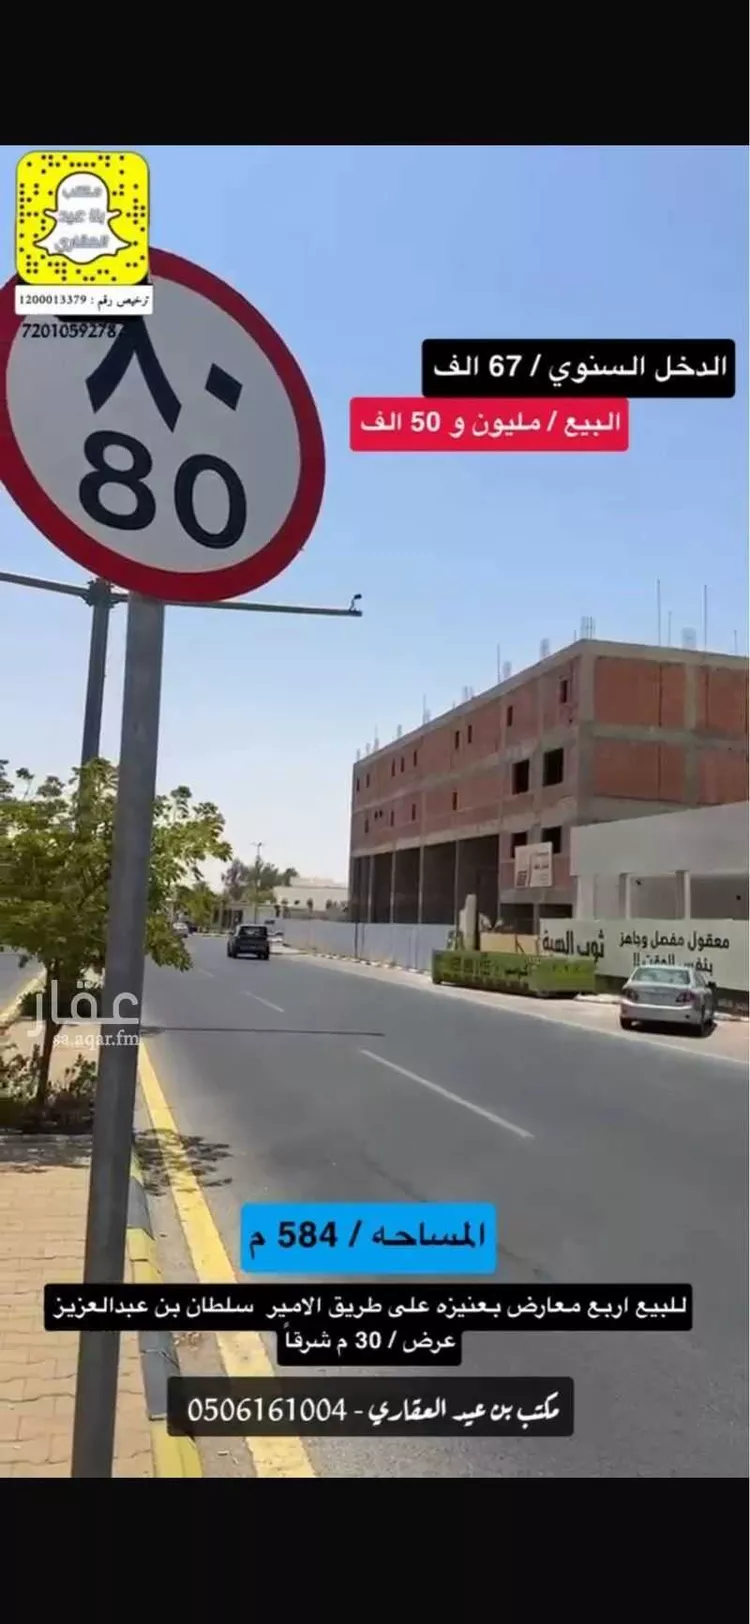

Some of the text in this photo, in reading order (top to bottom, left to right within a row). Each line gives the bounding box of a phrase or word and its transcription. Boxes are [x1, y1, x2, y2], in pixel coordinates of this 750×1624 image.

[79, 430, 247, 549] 80
[619, 930, 730, 951] معقول مفصل وجاهز
